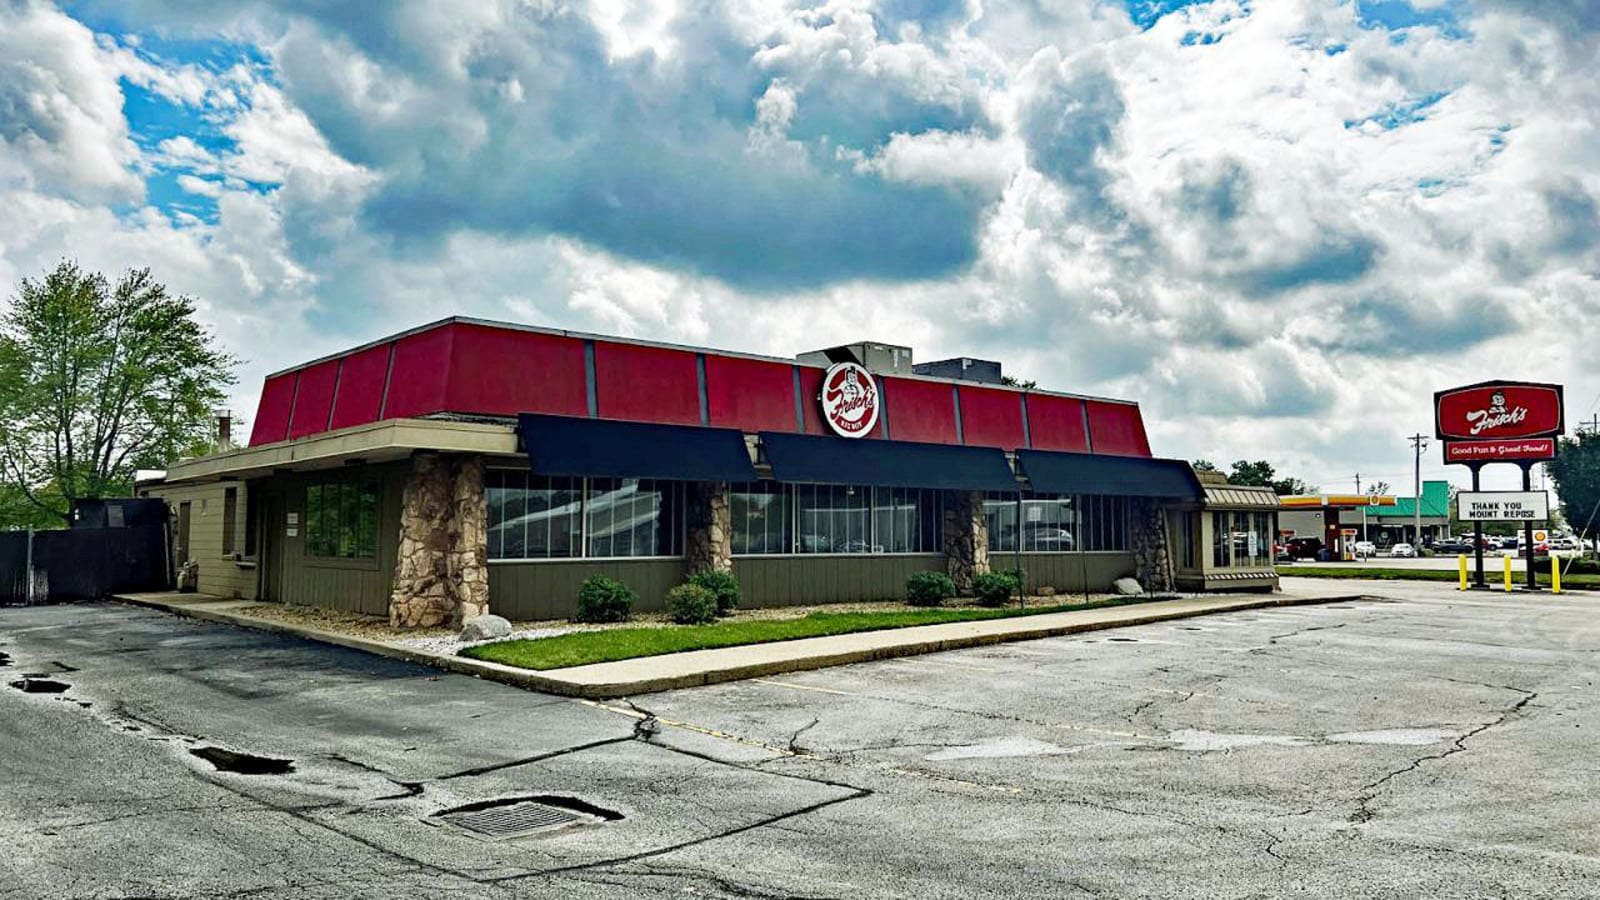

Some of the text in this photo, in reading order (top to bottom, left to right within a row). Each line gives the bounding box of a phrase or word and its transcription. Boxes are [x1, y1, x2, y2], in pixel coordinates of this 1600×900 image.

[827, 387, 875, 420] Frisch's
[1466, 406, 1528, 434] Frisch's
[1498, 445, 1521, 454] Great
[1523, 444, 1548, 452] Food!
[1472, 502, 1522, 510] THANK YOU
[1469, 510, 1535, 518] MOUNT REPOSE
